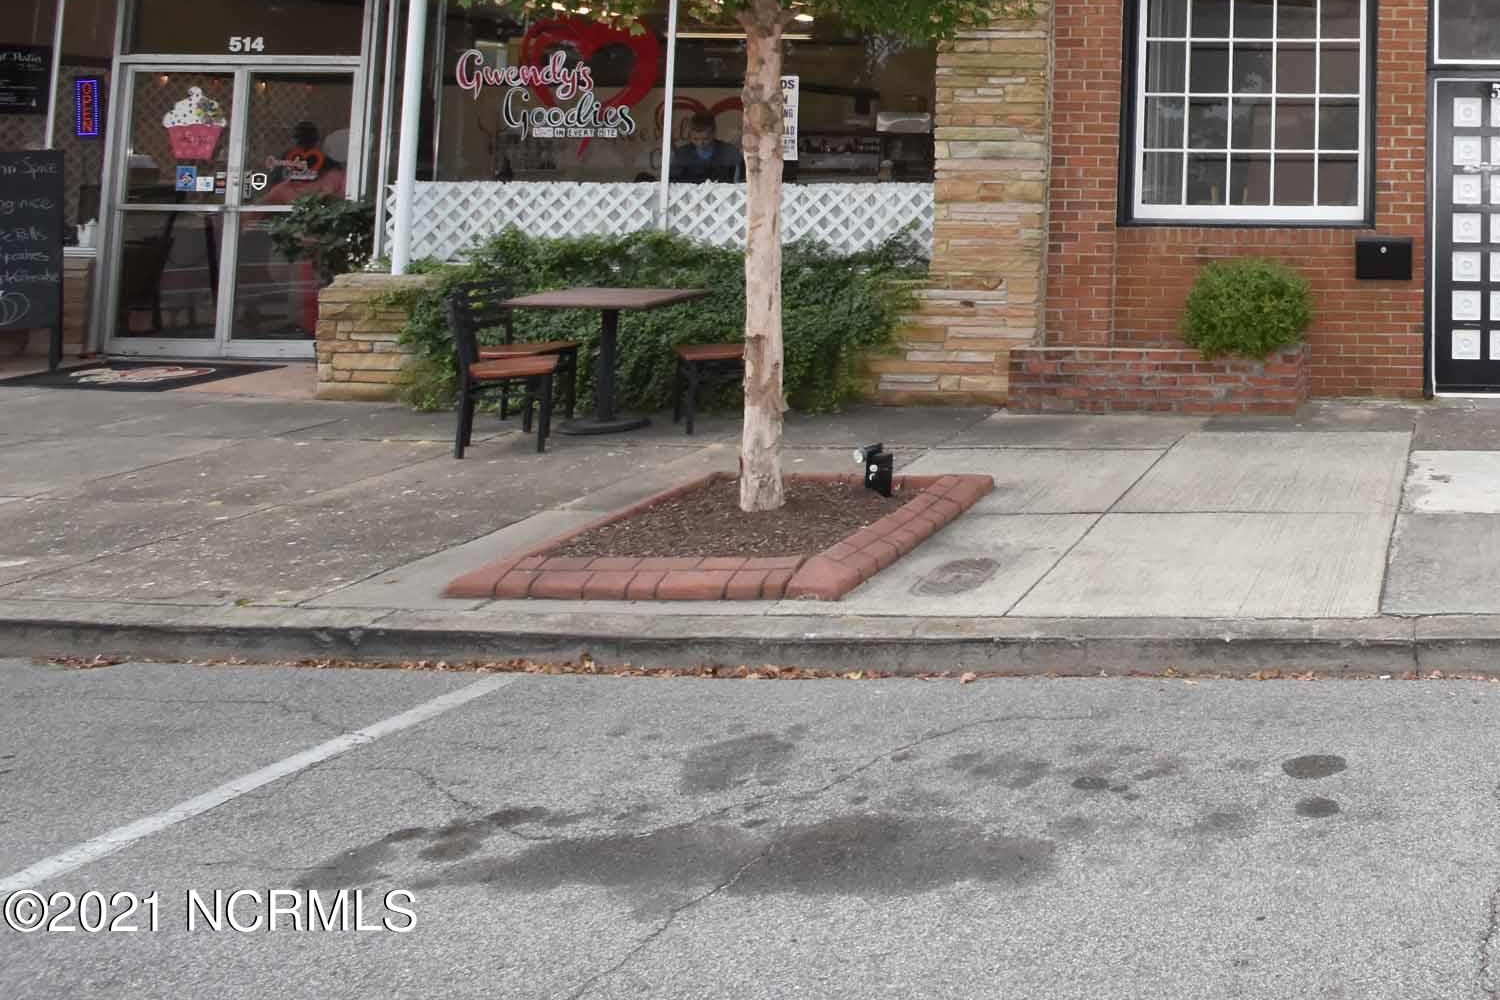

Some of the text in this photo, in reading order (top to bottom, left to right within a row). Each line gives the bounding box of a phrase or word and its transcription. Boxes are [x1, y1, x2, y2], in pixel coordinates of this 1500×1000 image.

[228, 36, 265, 52] 514
[456, 49, 594, 100] Gwendy's
[503, 87, 636, 141] Goodies
